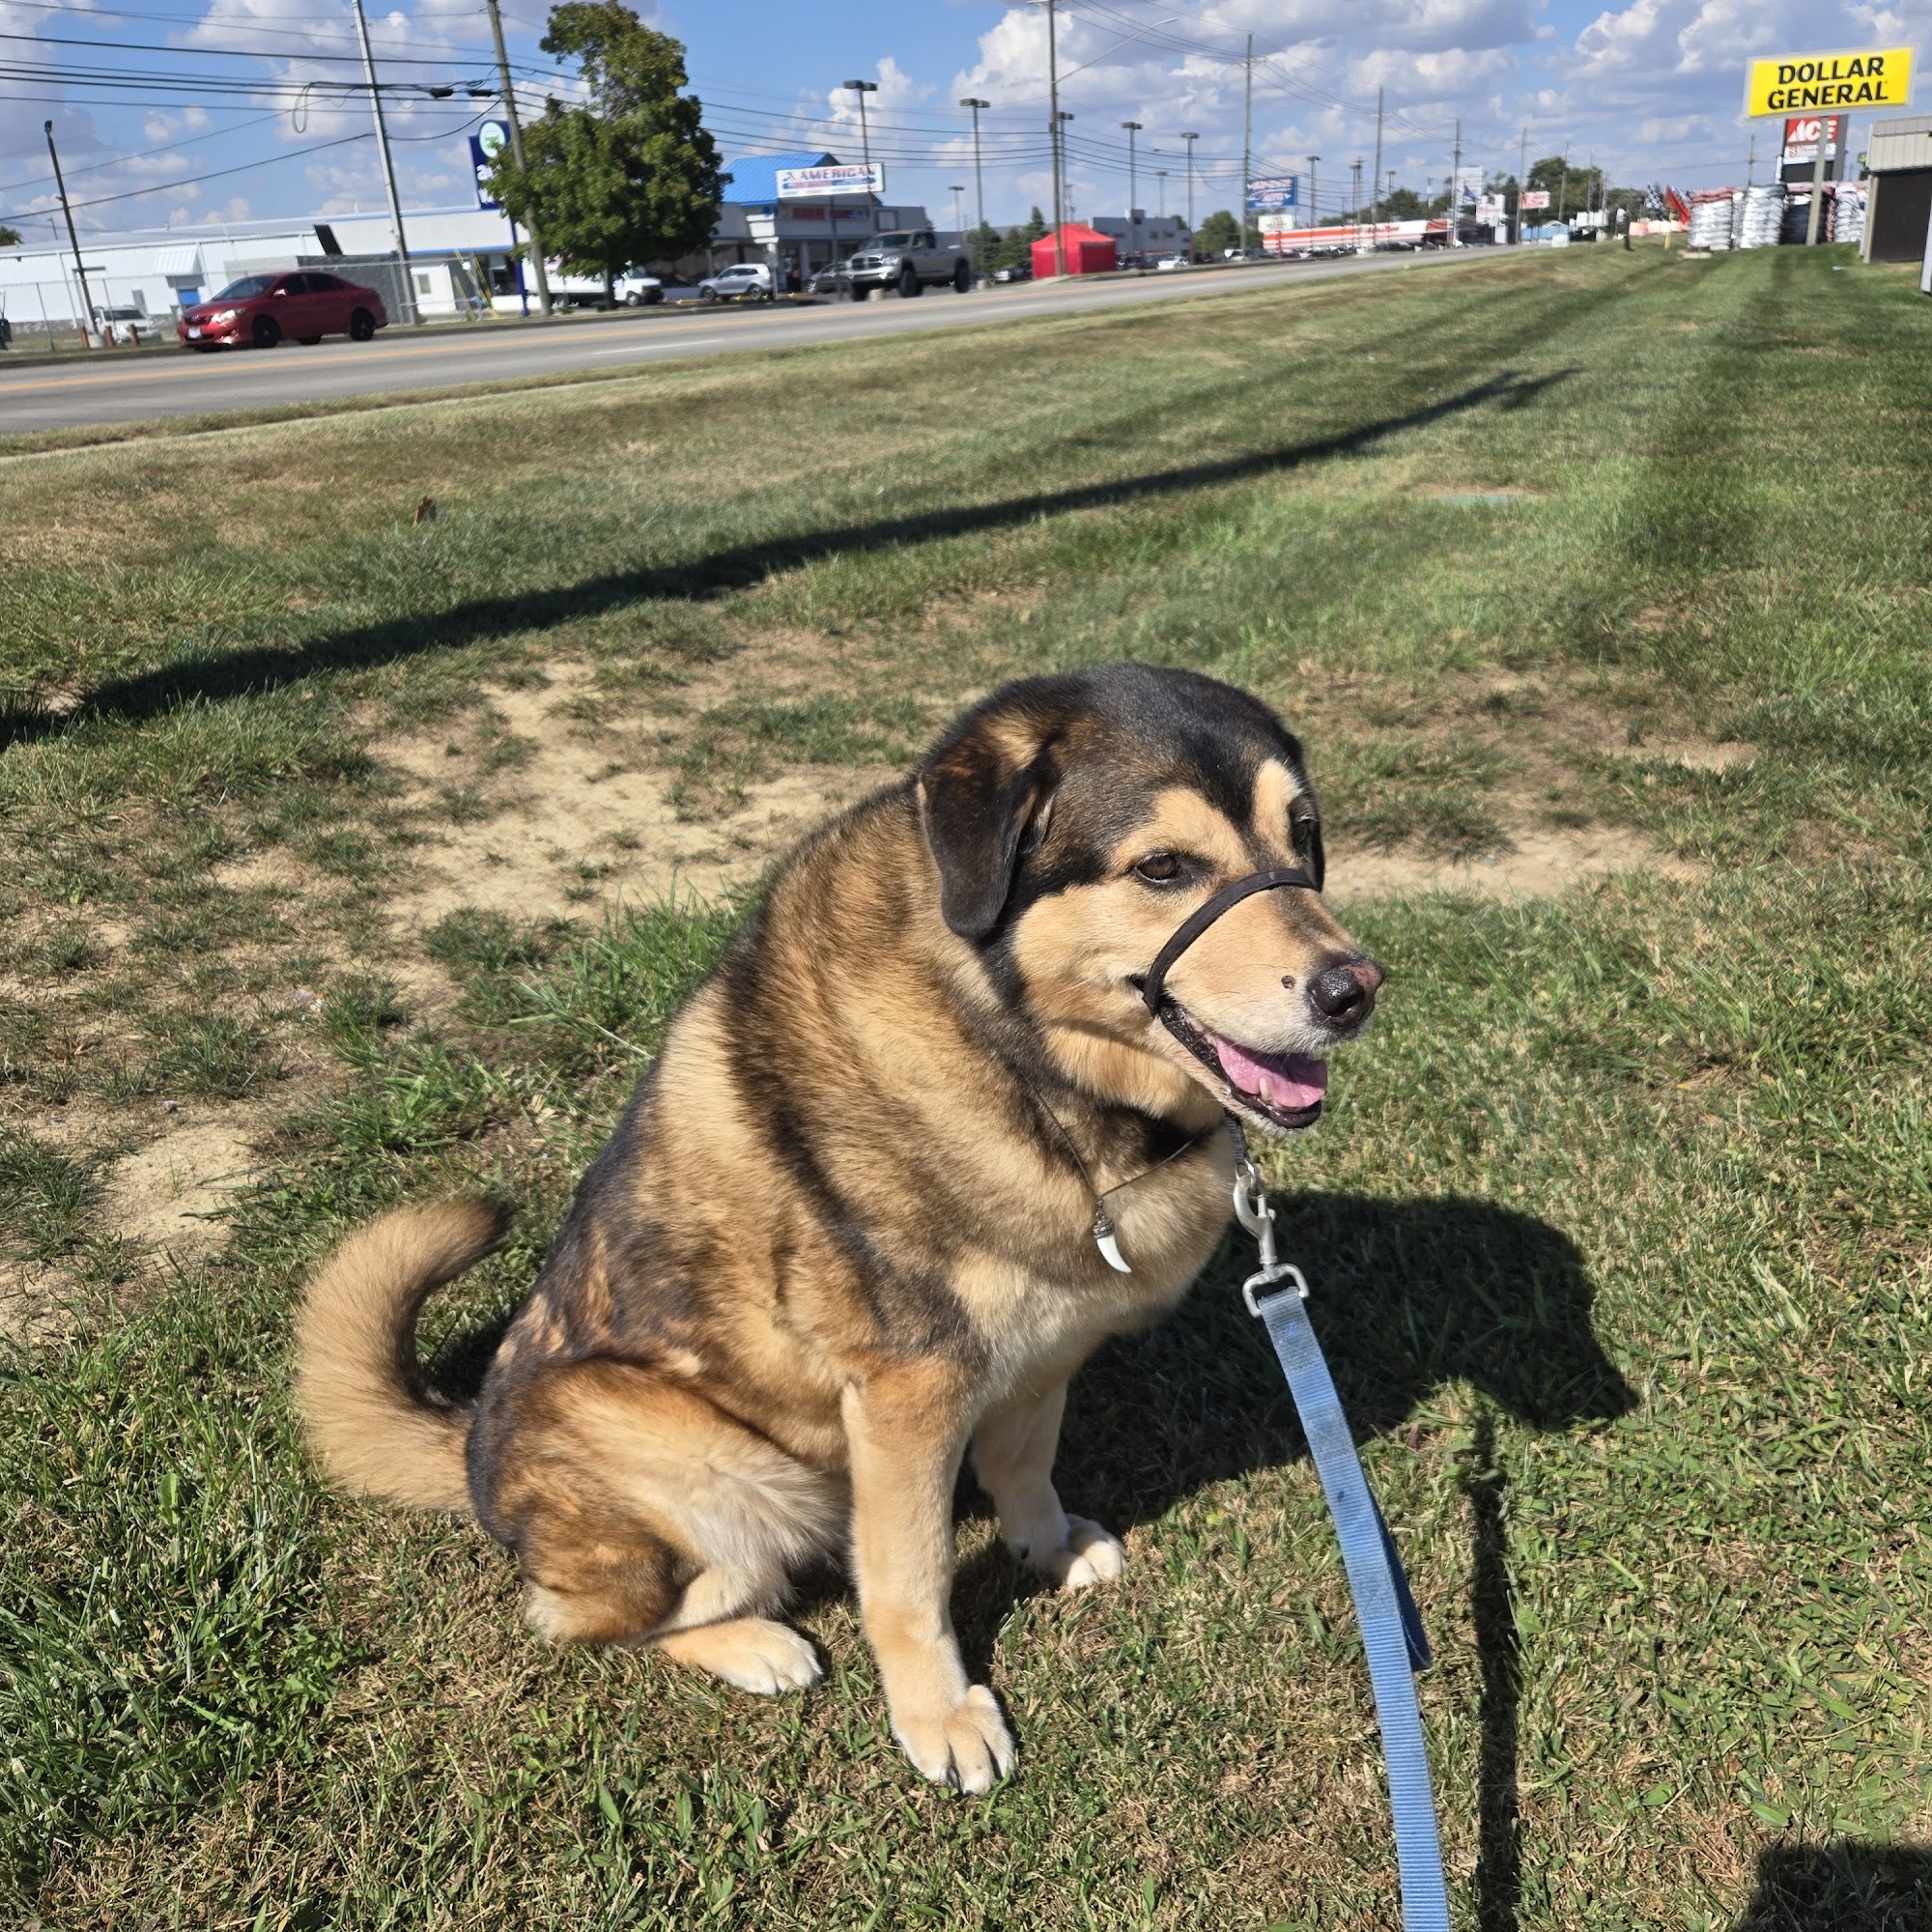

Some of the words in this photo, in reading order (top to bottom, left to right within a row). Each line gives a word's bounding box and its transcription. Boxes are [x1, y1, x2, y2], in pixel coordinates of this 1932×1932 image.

[1778, 56, 1884, 85] DOLLAR
[1768, 81, 1889, 109] GENERAL
[1787, 119, 1837, 142] ACE
